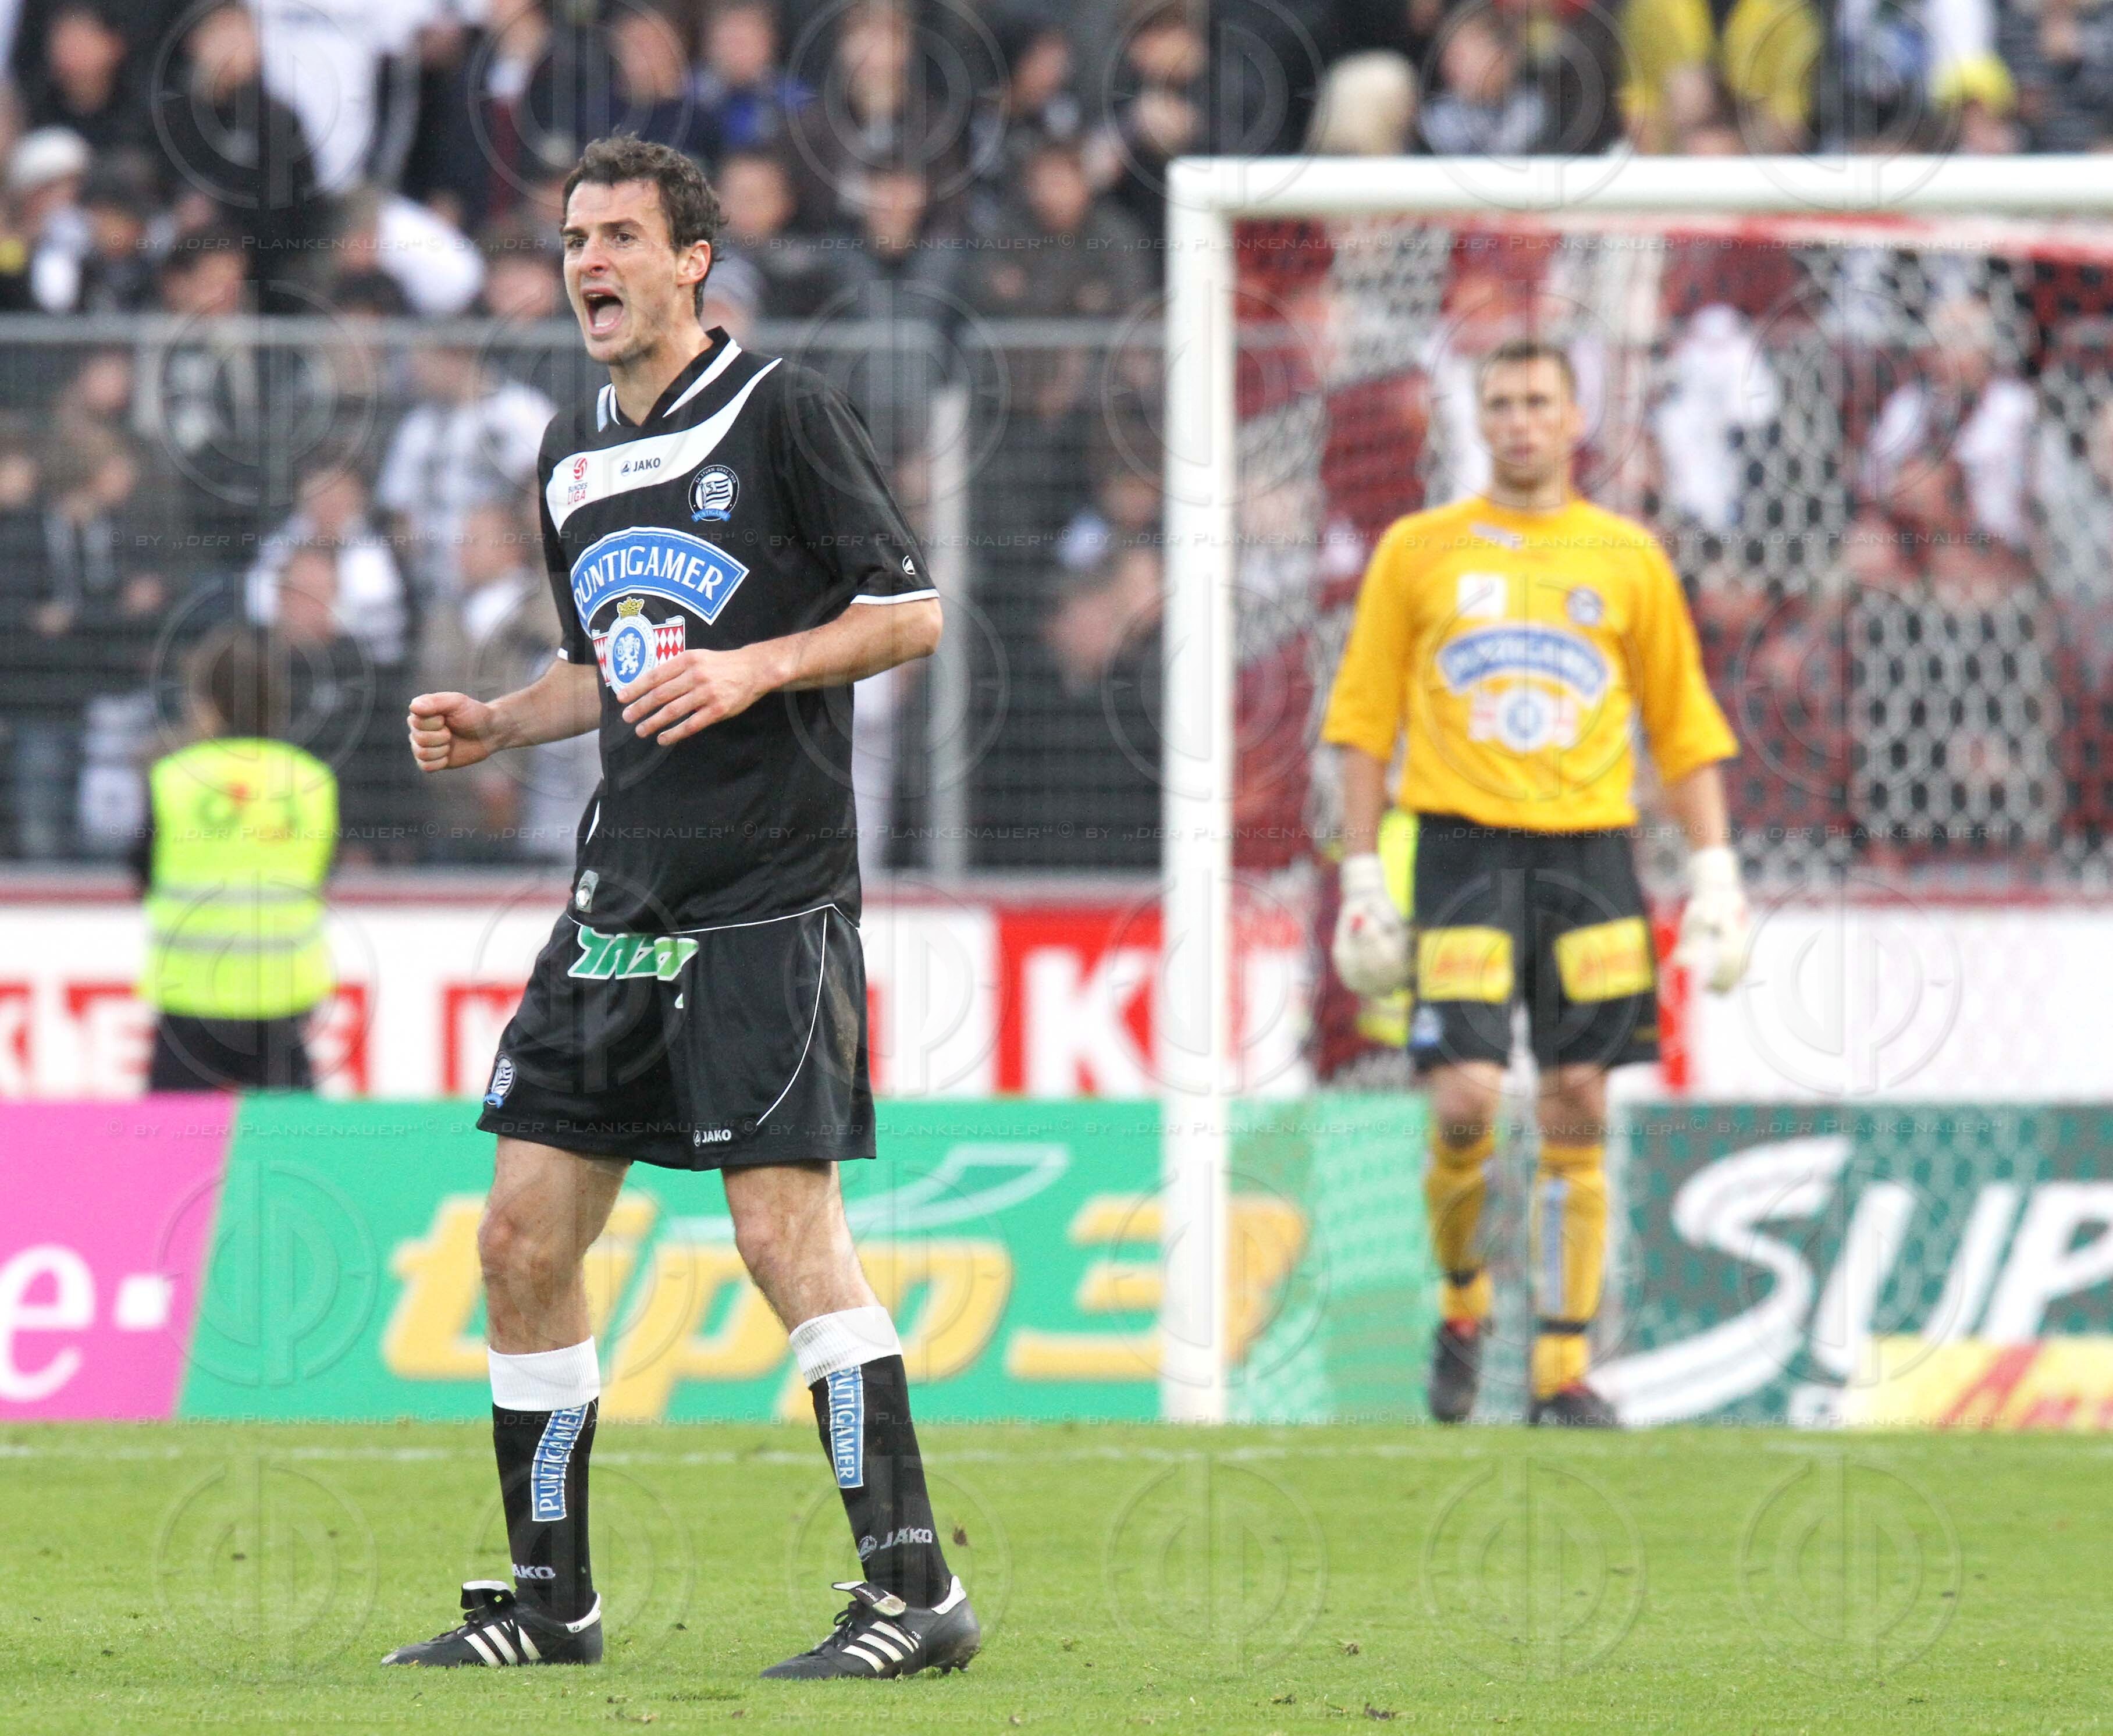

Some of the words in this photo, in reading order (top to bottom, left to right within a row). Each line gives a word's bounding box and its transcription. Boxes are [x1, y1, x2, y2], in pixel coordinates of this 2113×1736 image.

[633, 457, 661, 472] JAKO
[567, 489, 586, 505] LIGA
[574, 545, 724, 617] PUNTIGAMER
[702, 1129, 732, 1143] JAKO
[879, 1527, 933, 1550] JAKO
[512, 1563, 556, 1580] AKO
